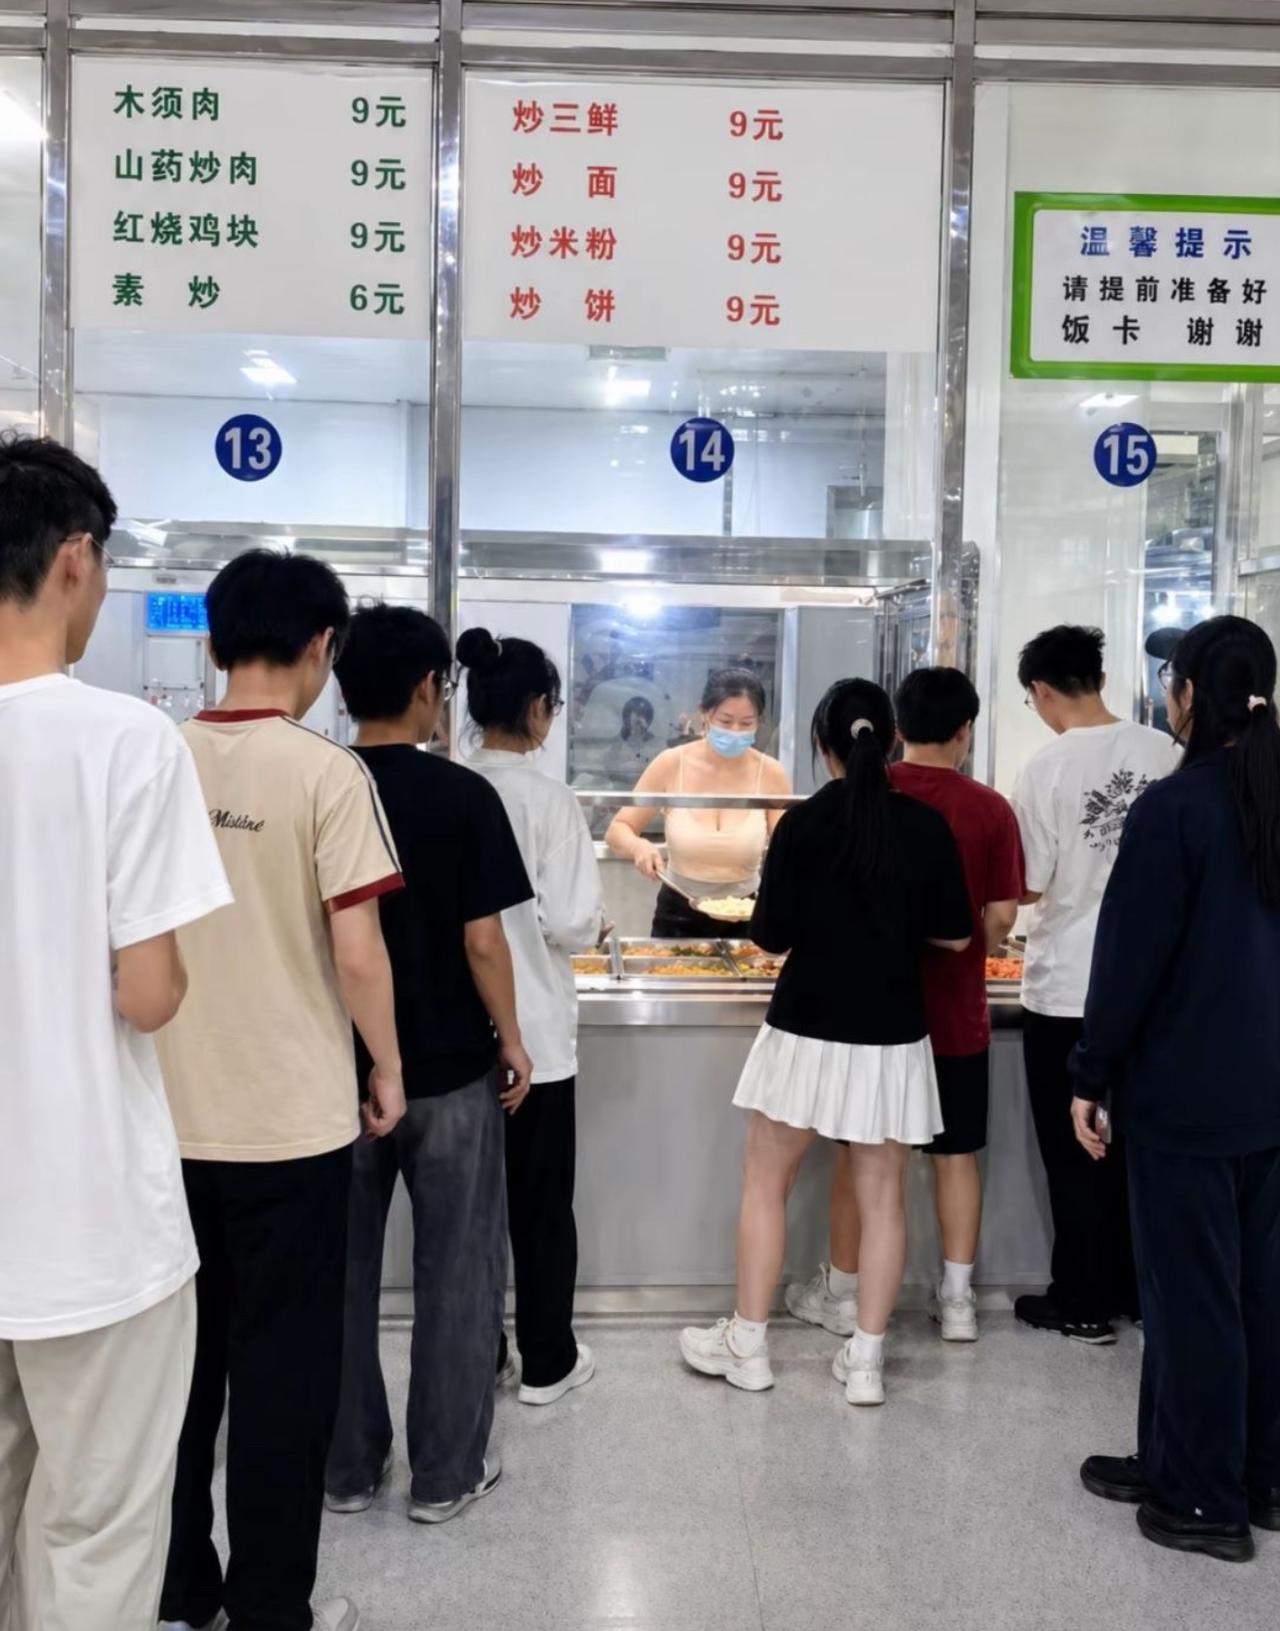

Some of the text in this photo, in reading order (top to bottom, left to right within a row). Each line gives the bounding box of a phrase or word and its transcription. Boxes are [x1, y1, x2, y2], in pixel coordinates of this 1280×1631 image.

[113, 84, 407, 128] 木须肉 9元
[512, 99, 784, 141] 炒三鲜 9元
[114, 148, 406, 191] 山药炒肉 9元
[728, 171, 783, 202] 9元
[112, 210, 406, 253] 红烧鸡块 9元
[511, 224, 782, 264] 炒米粉 9元
[1080, 225, 1252, 260] 温馨提示
[349, 283, 405, 315] 6元
[726, 294, 780, 326] 9元
[1062, 274, 1268, 305] 请提前准备好
[224, 427, 272, 470] 13
[679, 429, 726, 471] 14
[1102, 433, 1150, 476] 15
